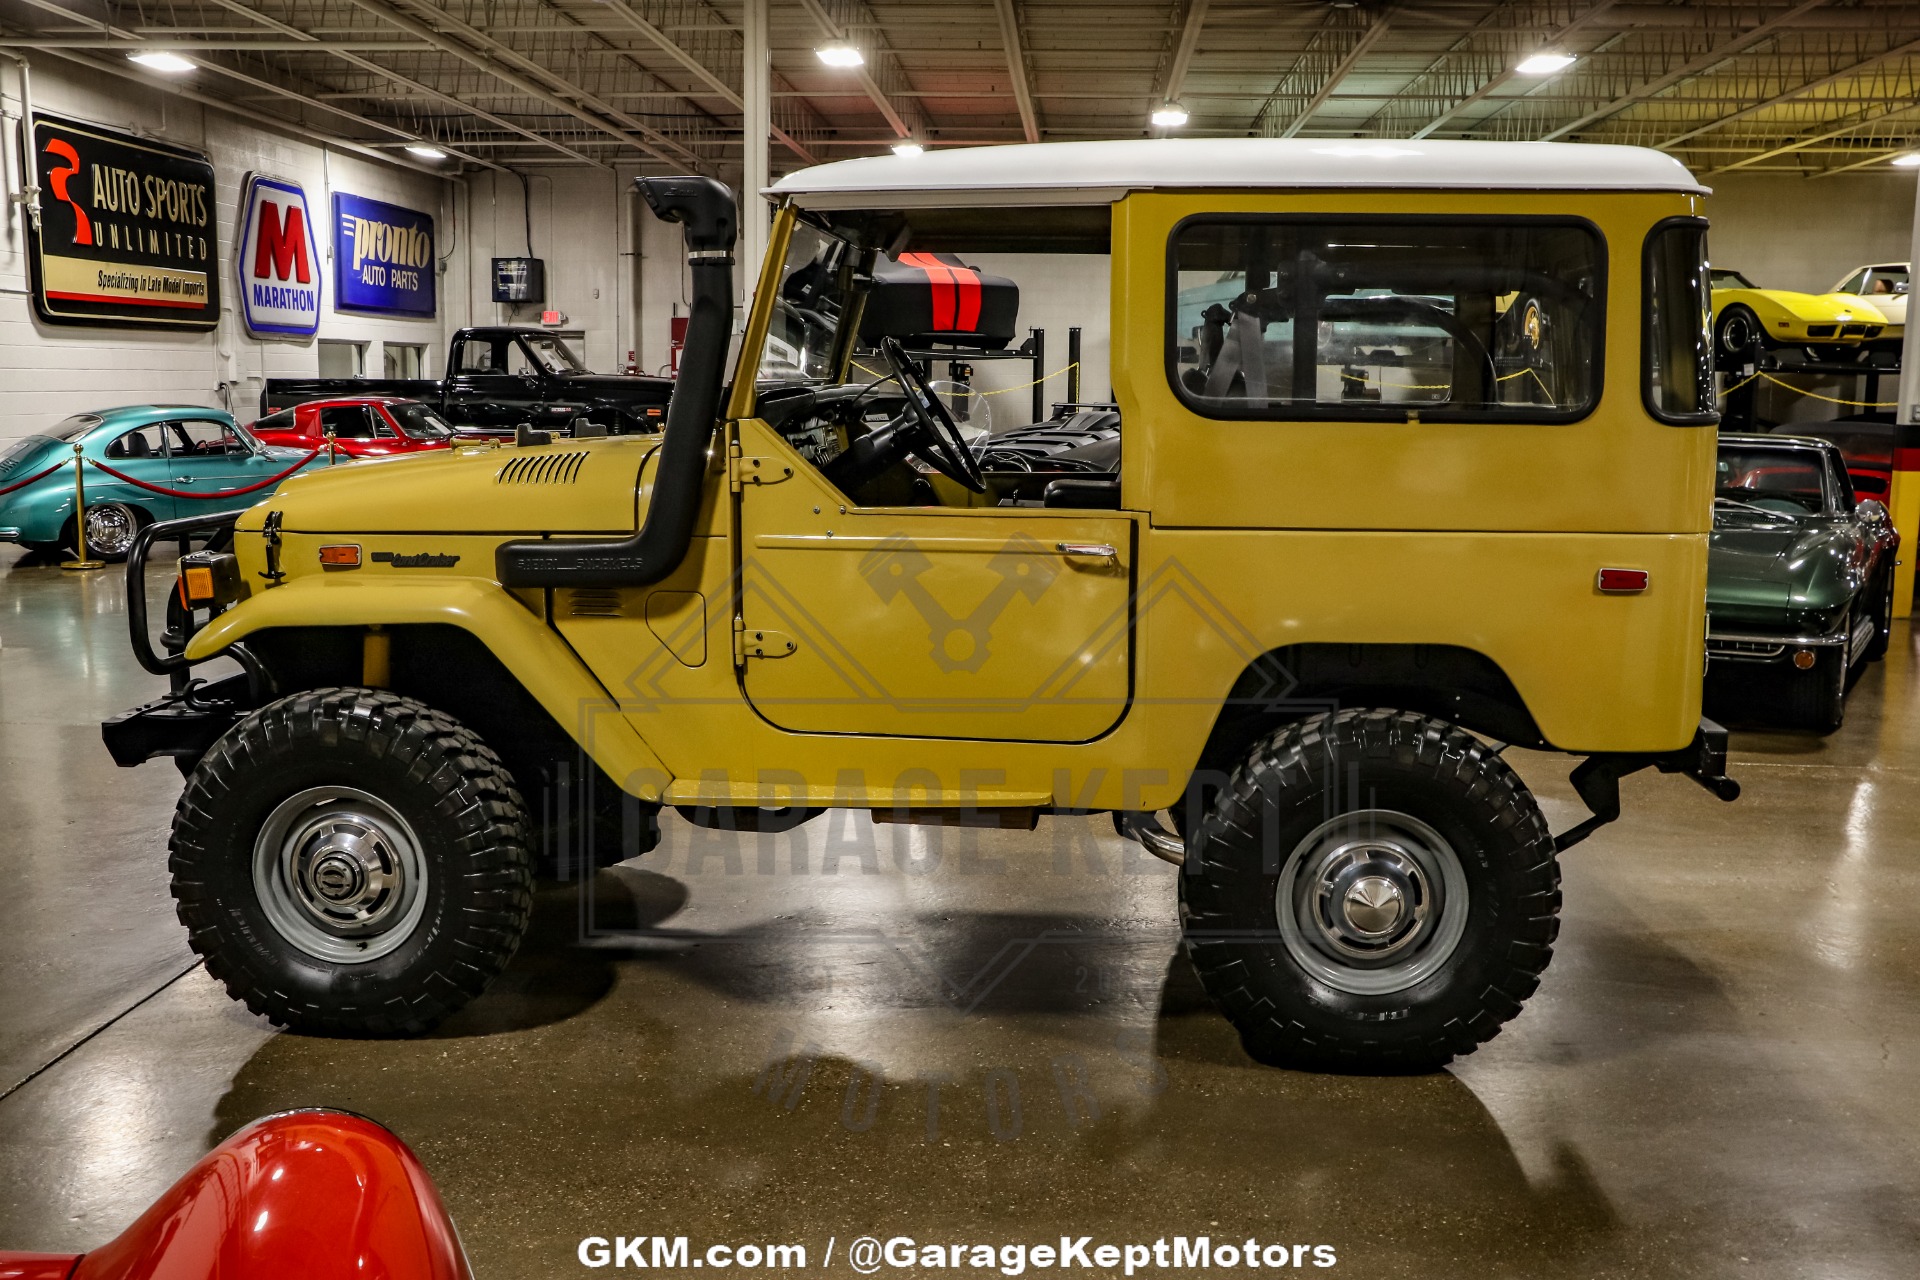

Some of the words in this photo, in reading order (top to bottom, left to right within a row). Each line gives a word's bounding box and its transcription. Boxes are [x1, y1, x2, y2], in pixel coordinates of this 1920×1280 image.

[92, 163, 140, 216] AUTO
[144, 174, 207, 228] SPORTS
[94, 221, 207, 261] UNLIMITED
[352, 217, 431, 270] pronto
[97, 269, 139, 294] Specializing
[148, 275, 161, 292] Late
[162, 275, 182, 295] Model
[182, 278, 205, 298] Imports
[362, 265, 386, 287] AUTO
[391, 268, 419, 291] PARTS
[253, 283, 315, 312] MARATHON
[544, 311, 559, 323] EXIT
